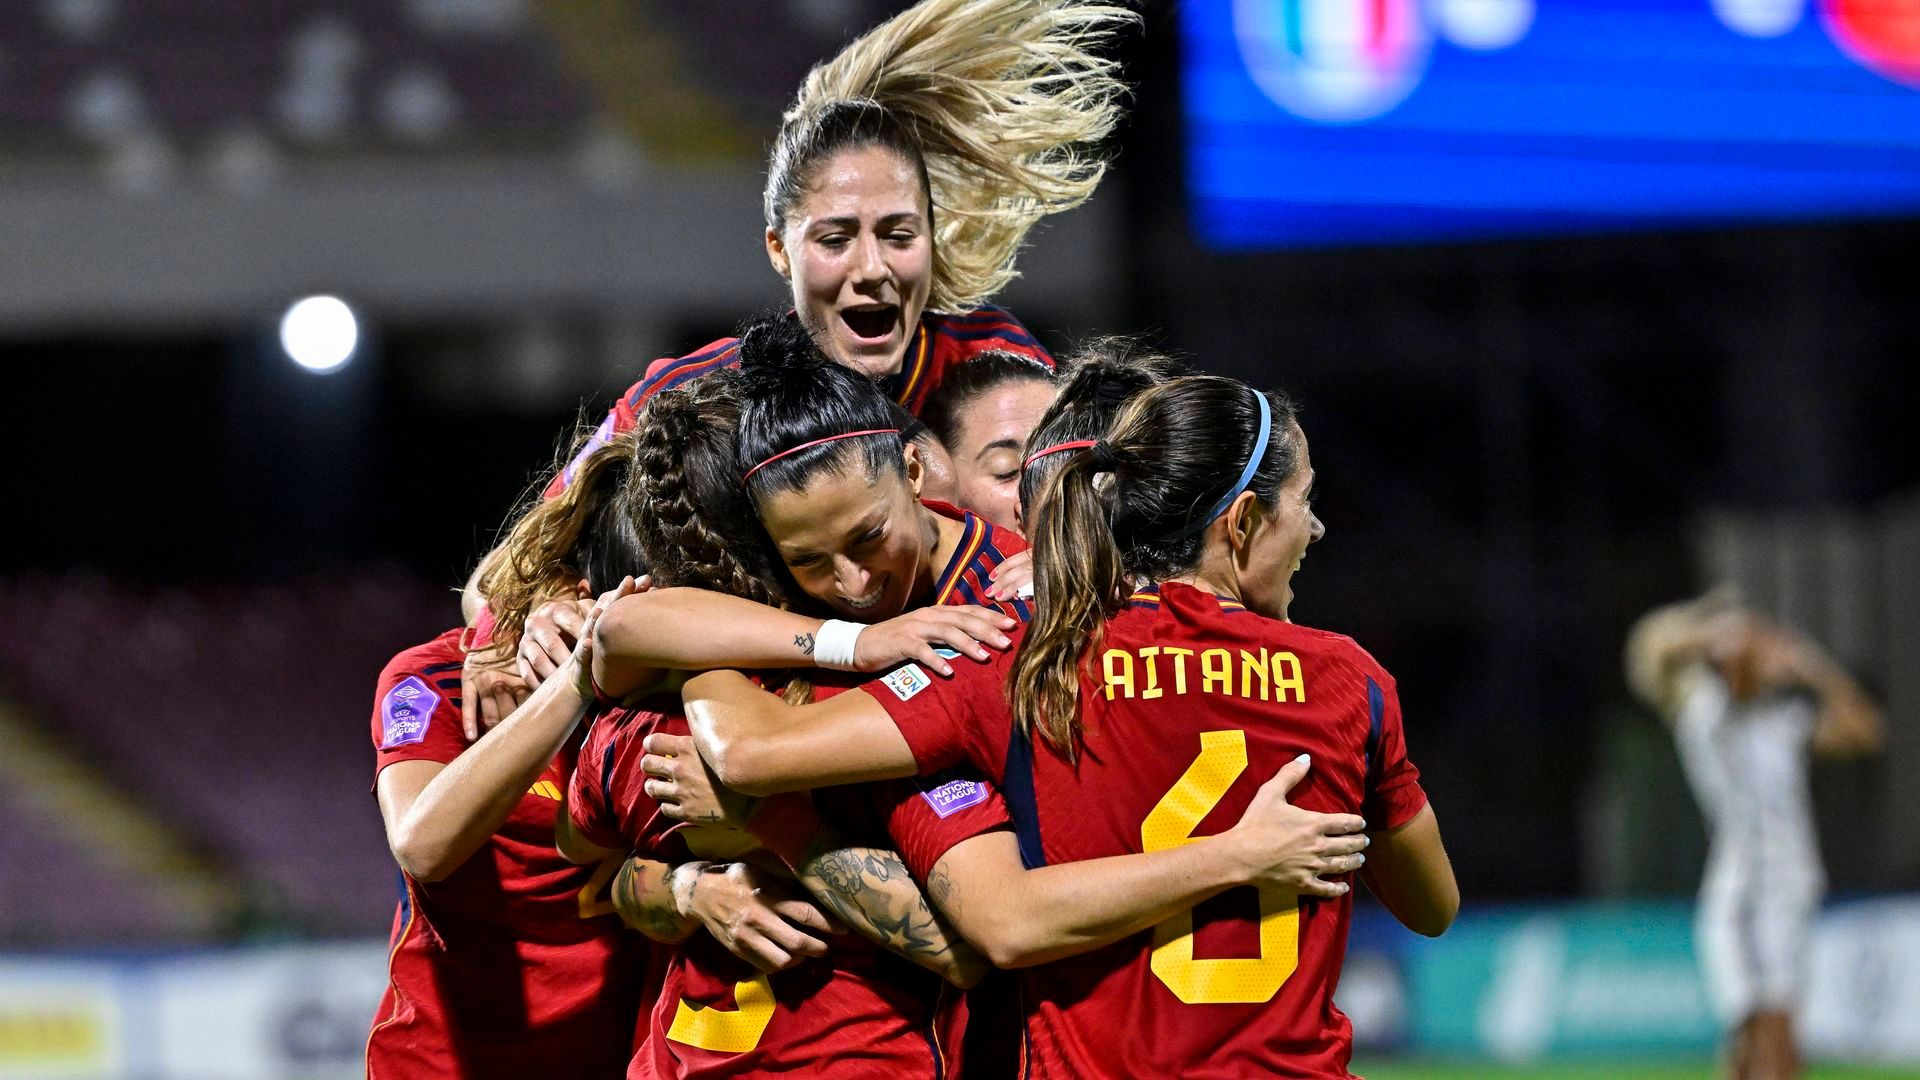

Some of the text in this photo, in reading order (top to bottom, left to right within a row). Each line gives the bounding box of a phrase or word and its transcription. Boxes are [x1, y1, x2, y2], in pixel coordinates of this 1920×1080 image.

[1103, 646, 1306, 703] AITANA
[387, 721, 421, 737] NATIONS
[387, 727, 418, 743] LEAGUE
[932, 781, 976, 801] NATIONS
[939, 786, 977, 806] LEAGUE
[1141, 729, 1300, 1005] 6
